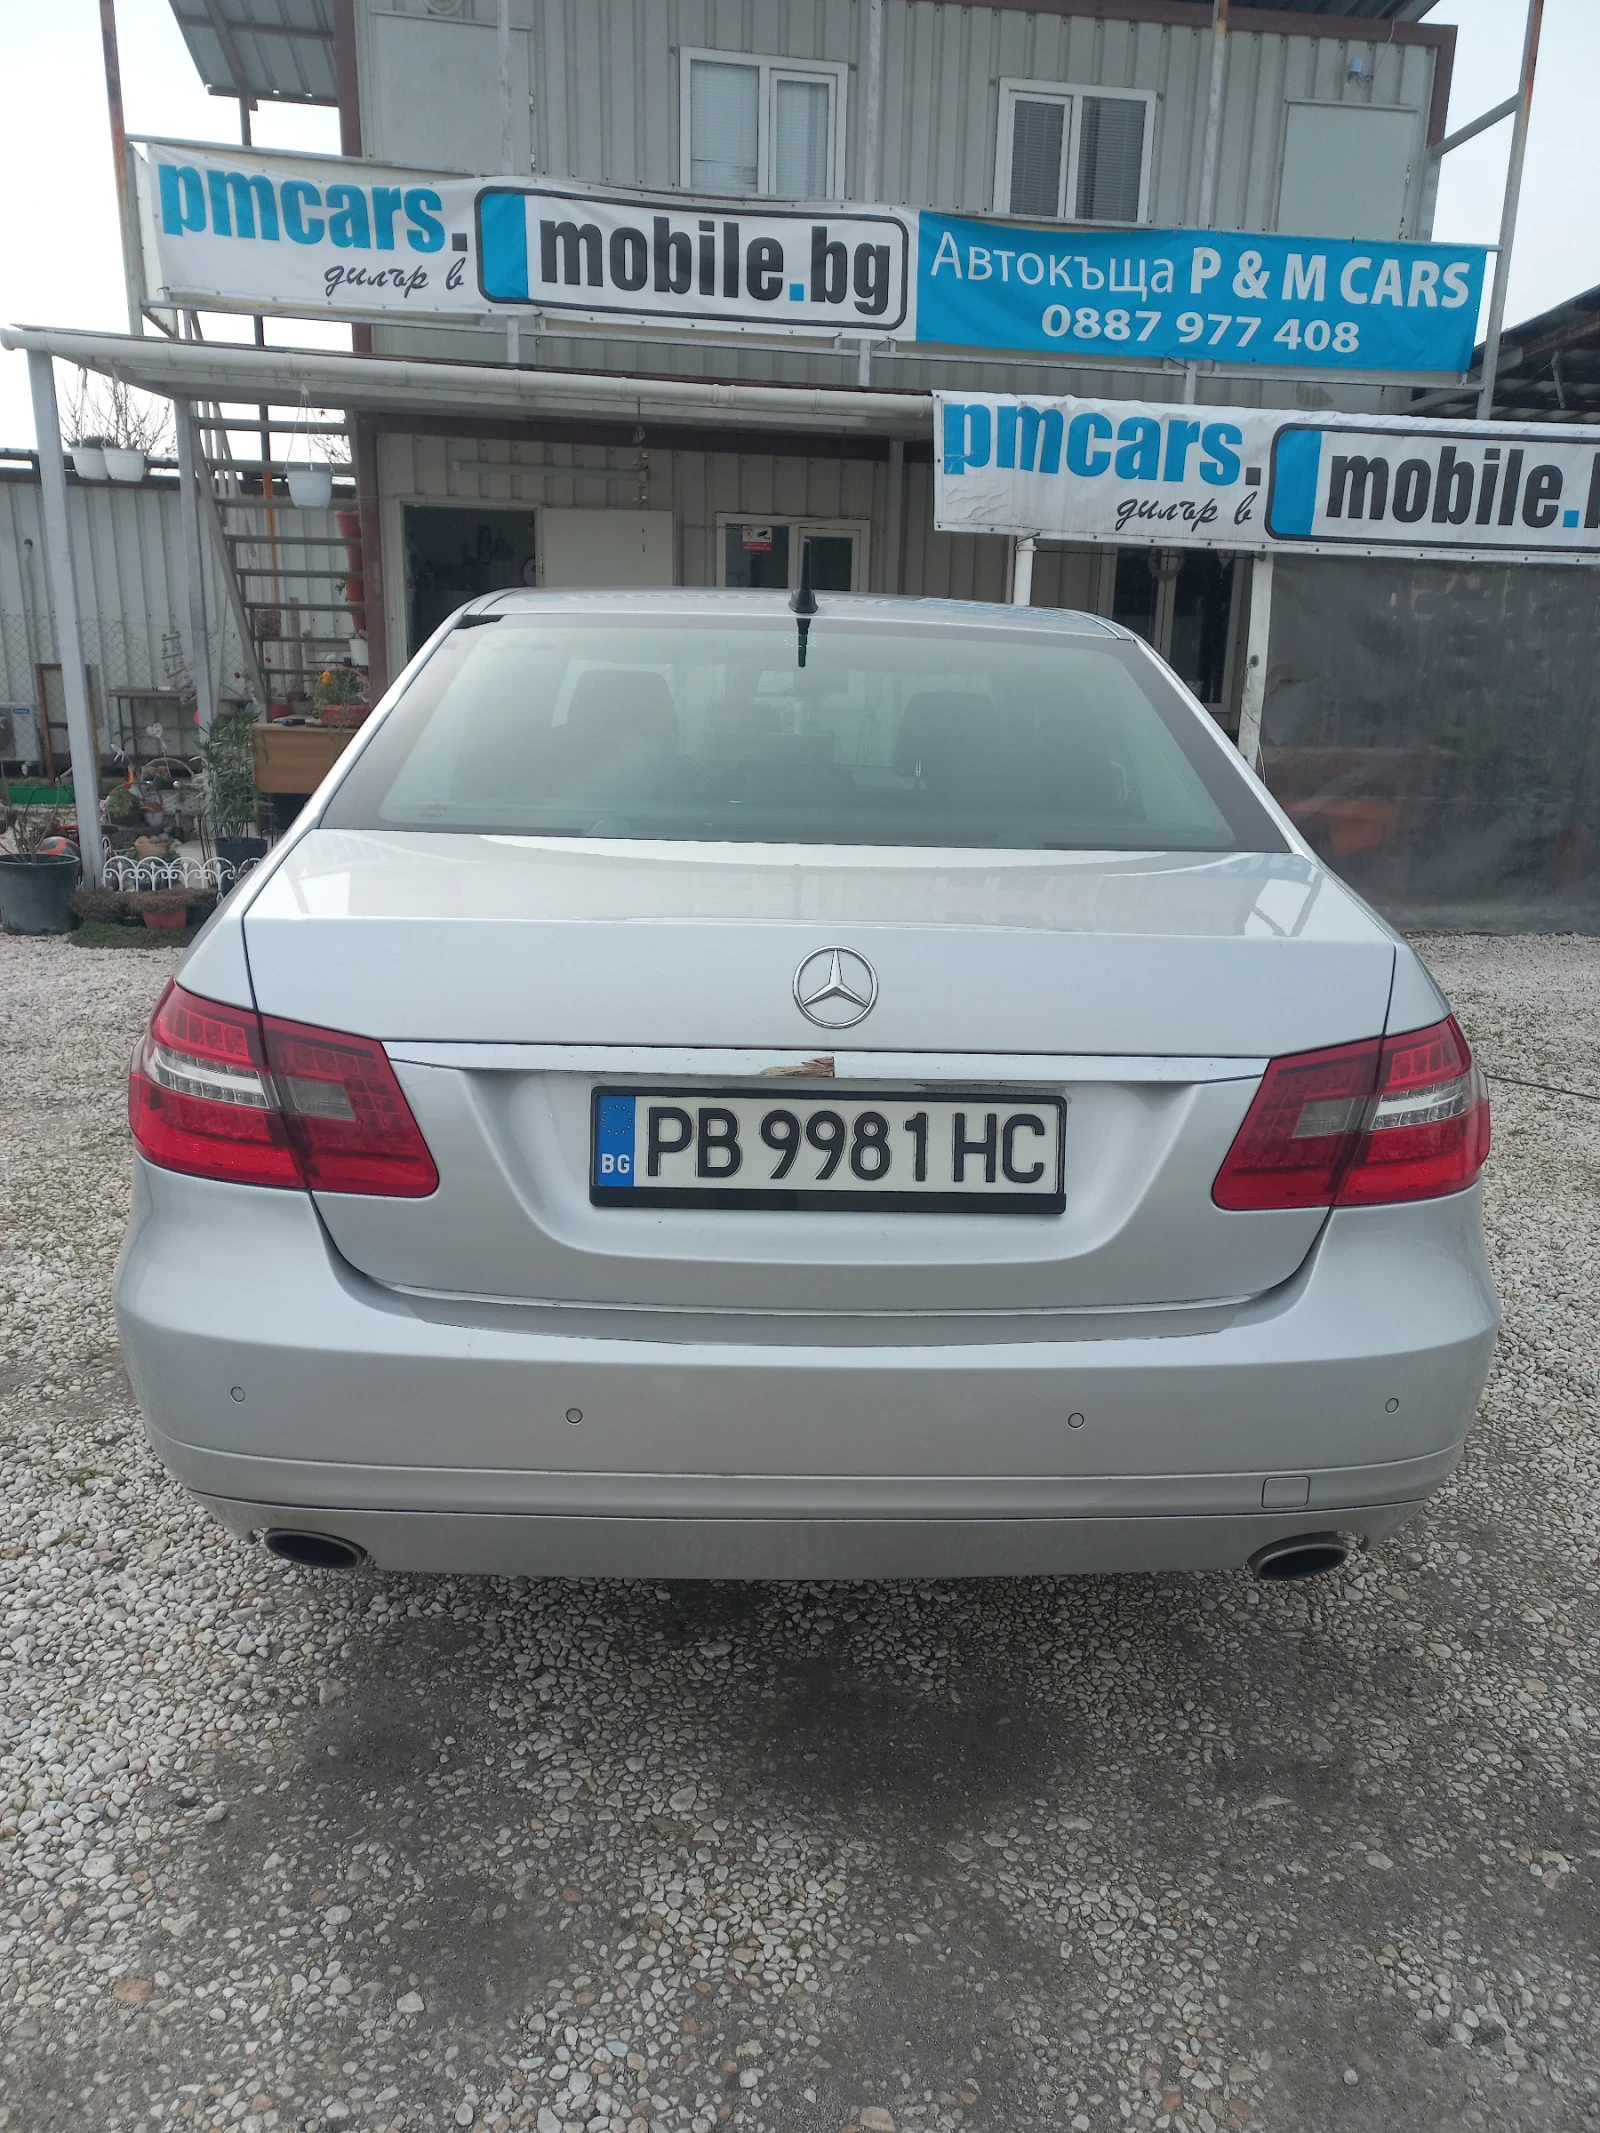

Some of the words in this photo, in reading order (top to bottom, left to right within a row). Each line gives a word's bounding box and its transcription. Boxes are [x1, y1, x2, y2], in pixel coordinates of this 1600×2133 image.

[158, 163, 468, 253] pmcars.
[323, 263, 429, 297] дилър
[445, 257, 466, 291] в
[539, 216, 891, 316] mobile.bg
[930, 231, 1174, 302] Автокъща
[1189, 246, 1222, 294] P
[1232, 250, 1271, 299] &
[1281, 253, 1327, 302] M
[1339, 256, 1471, 308] CARS
[1041, 304, 1162, 341] 0887
[1175, 311, 1262, 348] 977
[1273, 318, 1360, 353] 408
[943, 403, 1262, 486] pmcars.
[1115, 498, 1219, 532] дилър
[1233, 491, 1258, 525] в
[600, 1153, 630, 1174] BG
